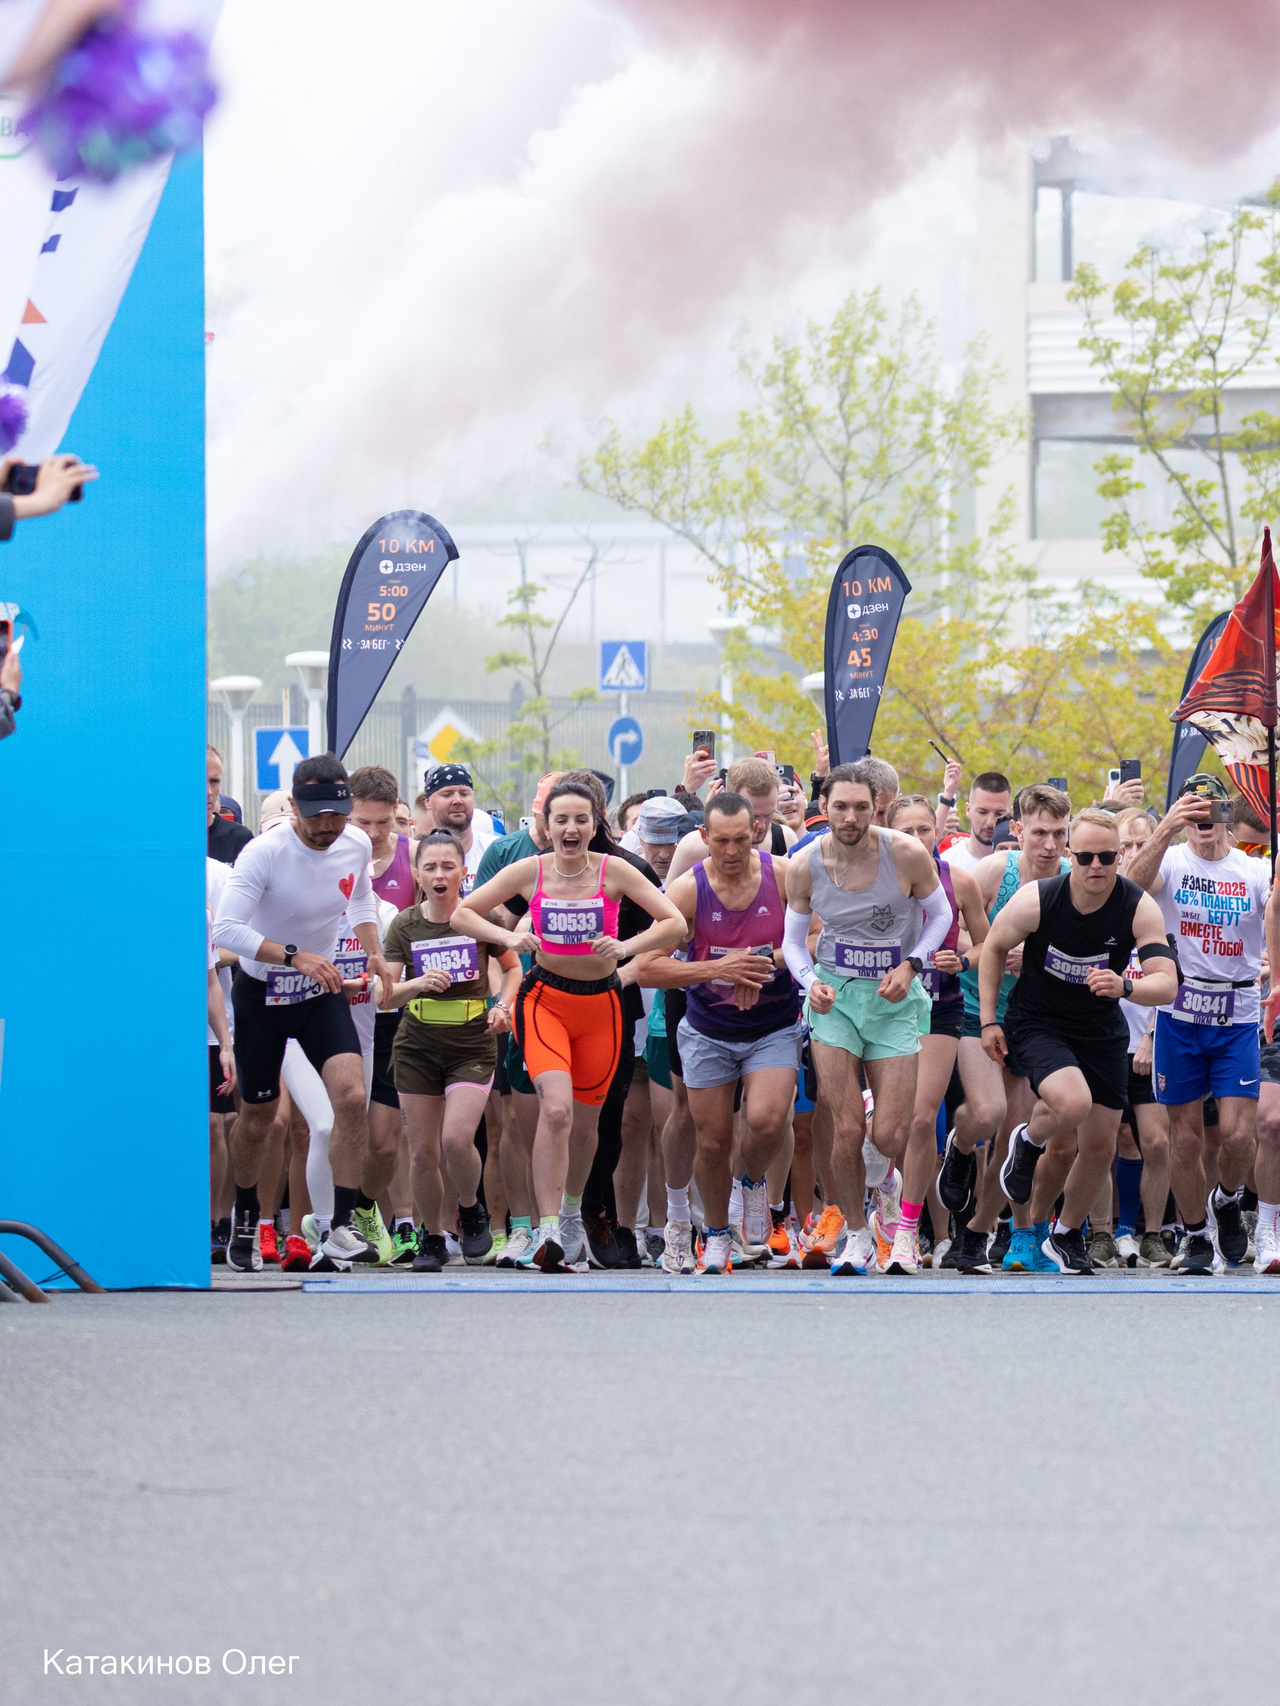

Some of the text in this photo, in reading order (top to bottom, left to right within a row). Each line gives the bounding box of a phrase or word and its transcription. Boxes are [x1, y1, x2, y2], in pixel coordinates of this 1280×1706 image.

[379, 539, 400, 554] 10
[379, 585, 408, 597] 5:00
[843, 580, 862, 597] 10
[367, 602, 396, 621] 50
[852, 628, 879, 643] 4:30
[847, 647, 872, 667] 45
[1174, 888, 1251, 912] 45% ПЛАНЕТЫ
[548, 912, 597, 932] 30533
[1208, 911, 1240, 926] БЕГУТ
[1181, 920, 1223, 940] ВМЕСТЕ
[1202, 939, 1244, 956] С ТОБОЙ
[421, 949, 471, 975] 30534
[844, 949, 892, 967] 30816
[1182, 991, 1227, 1014] 30341
